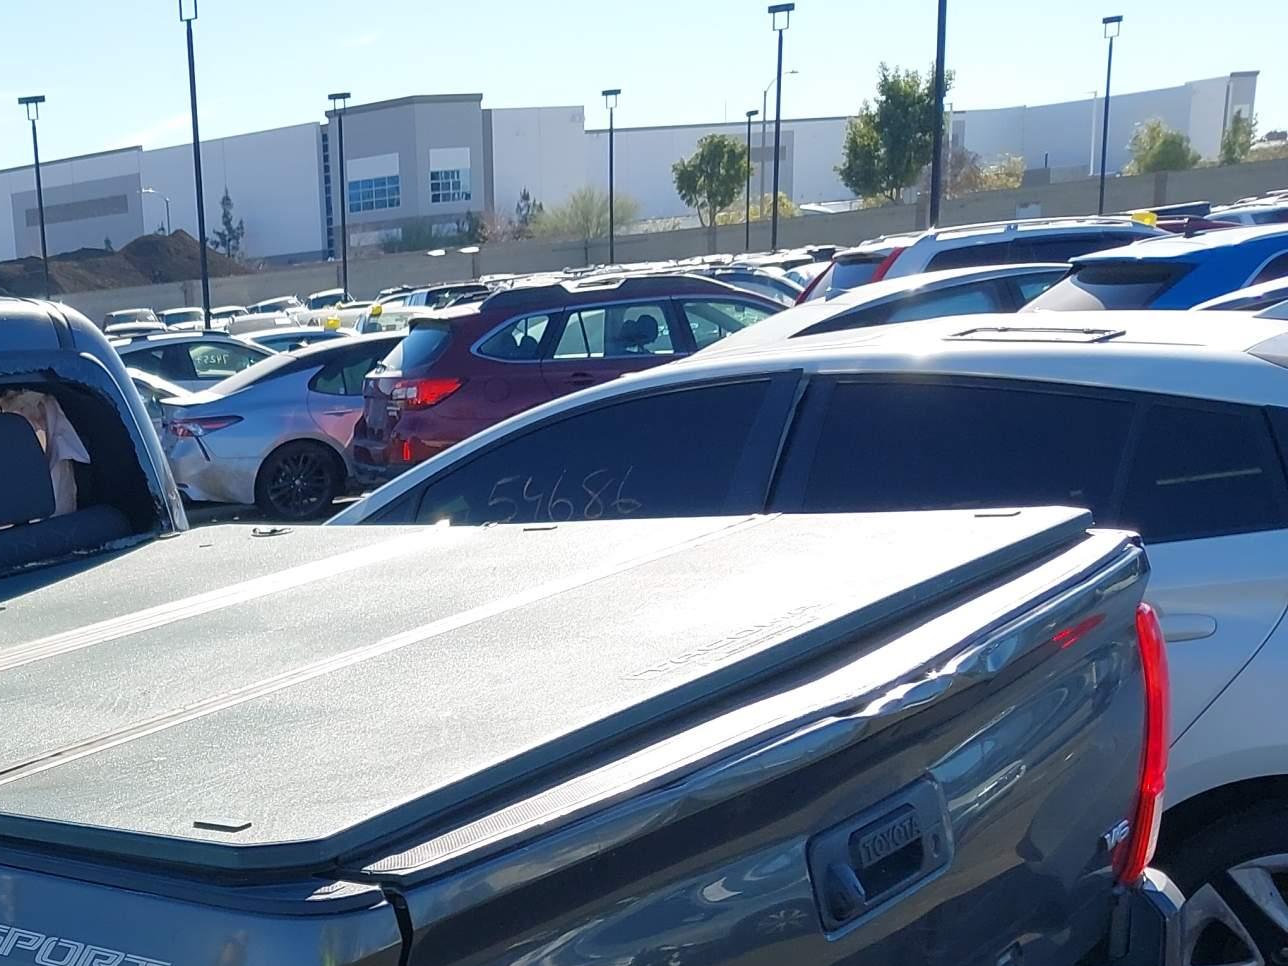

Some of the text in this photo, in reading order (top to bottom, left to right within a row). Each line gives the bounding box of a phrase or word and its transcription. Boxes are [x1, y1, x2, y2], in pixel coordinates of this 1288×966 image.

[487, 464, 643, 523] 54686
[861, 815, 922, 862] TOYOTA
[1104, 819, 1130, 851] V6
